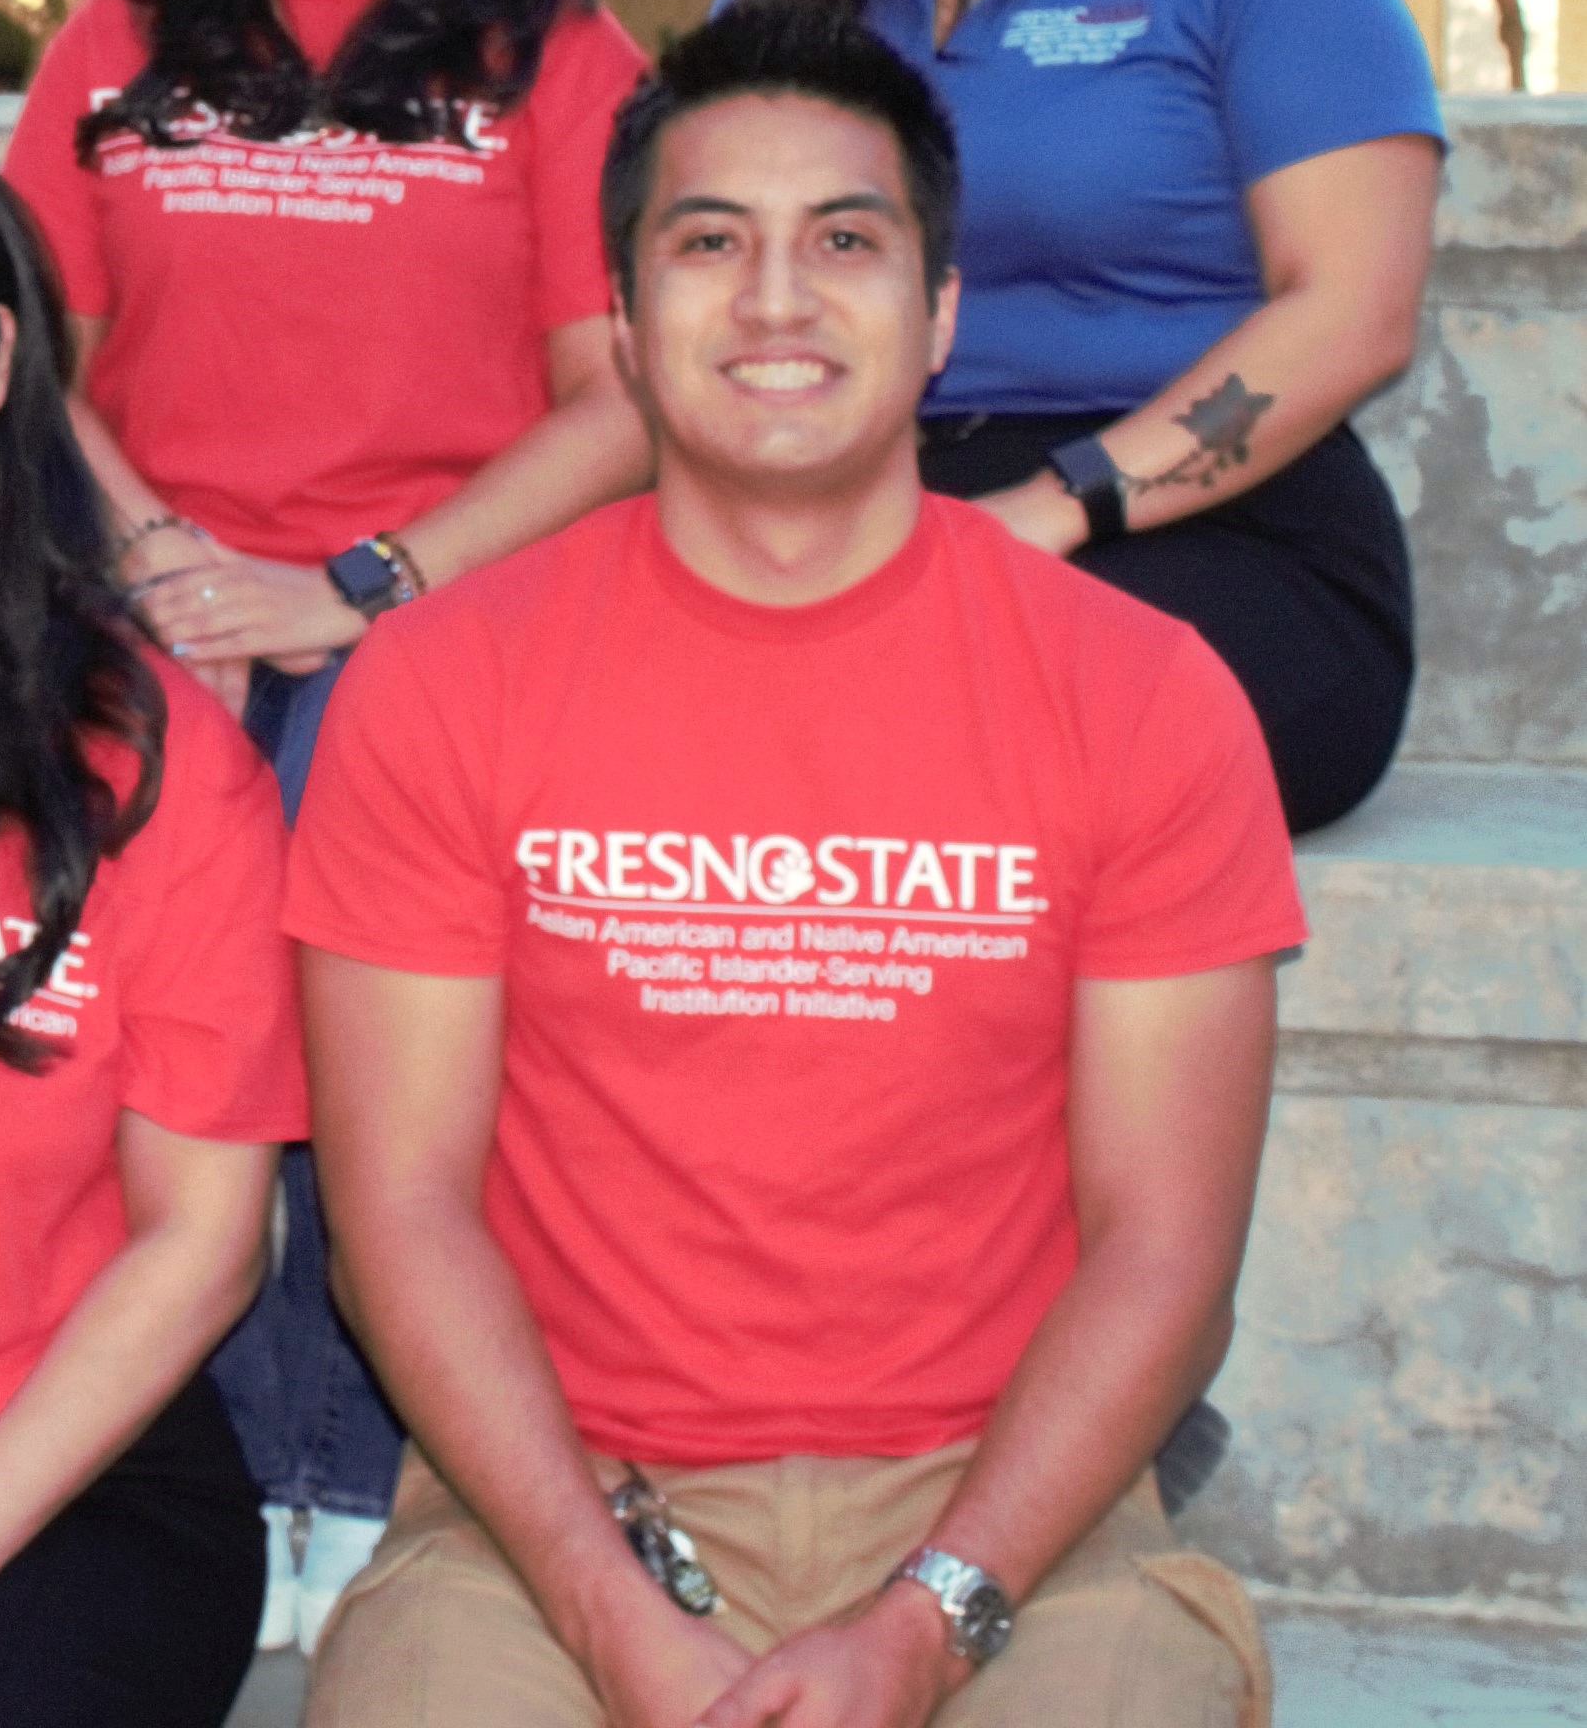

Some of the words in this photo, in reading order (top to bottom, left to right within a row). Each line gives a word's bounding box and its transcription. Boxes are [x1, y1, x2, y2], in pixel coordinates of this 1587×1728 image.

[142, 165, 217, 191] Pacific
[371, 151, 484, 185] American
[275, 194, 374, 222] Initiative
[525, 903, 597, 941] Asian
[599, 915, 735, 949] American
[740, 922, 795, 951] and
[800, 923, 885, 954] Native
[889, 925, 1028, 960] American
[607, 947, 704, 982] Pacific
[640, 983, 780, 1017] Institution
[785, 987, 897, 1021] Initiative
